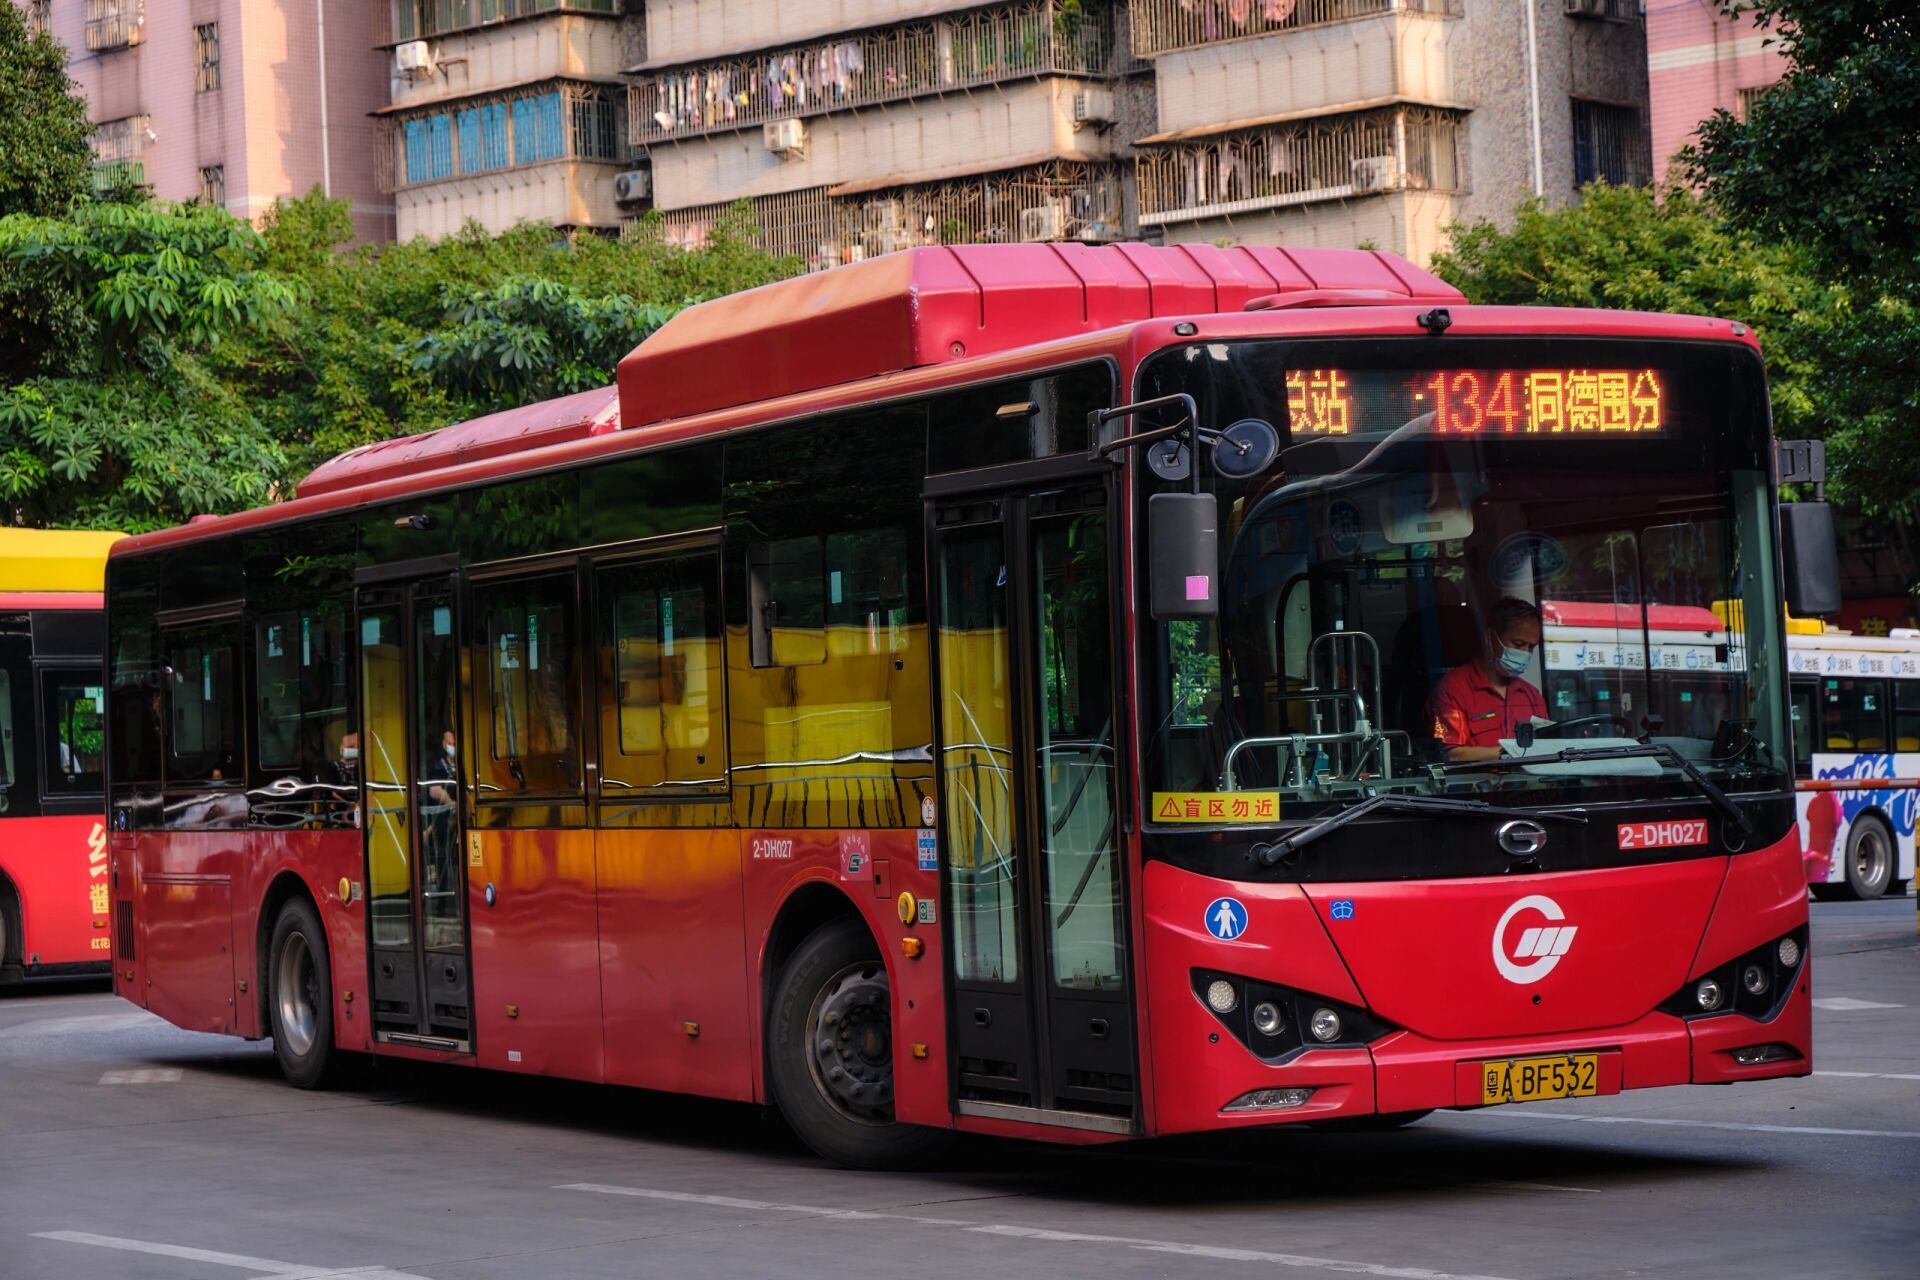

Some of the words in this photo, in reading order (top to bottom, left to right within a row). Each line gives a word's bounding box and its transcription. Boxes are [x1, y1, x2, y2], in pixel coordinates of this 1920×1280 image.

[1428, 372, 1519, 432] 134
[1183, 798, 1273, 818] 盲区勿近
[1620, 822, 1705, 847] 2-DH027
[753, 839, 793, 858] 2-DH027
